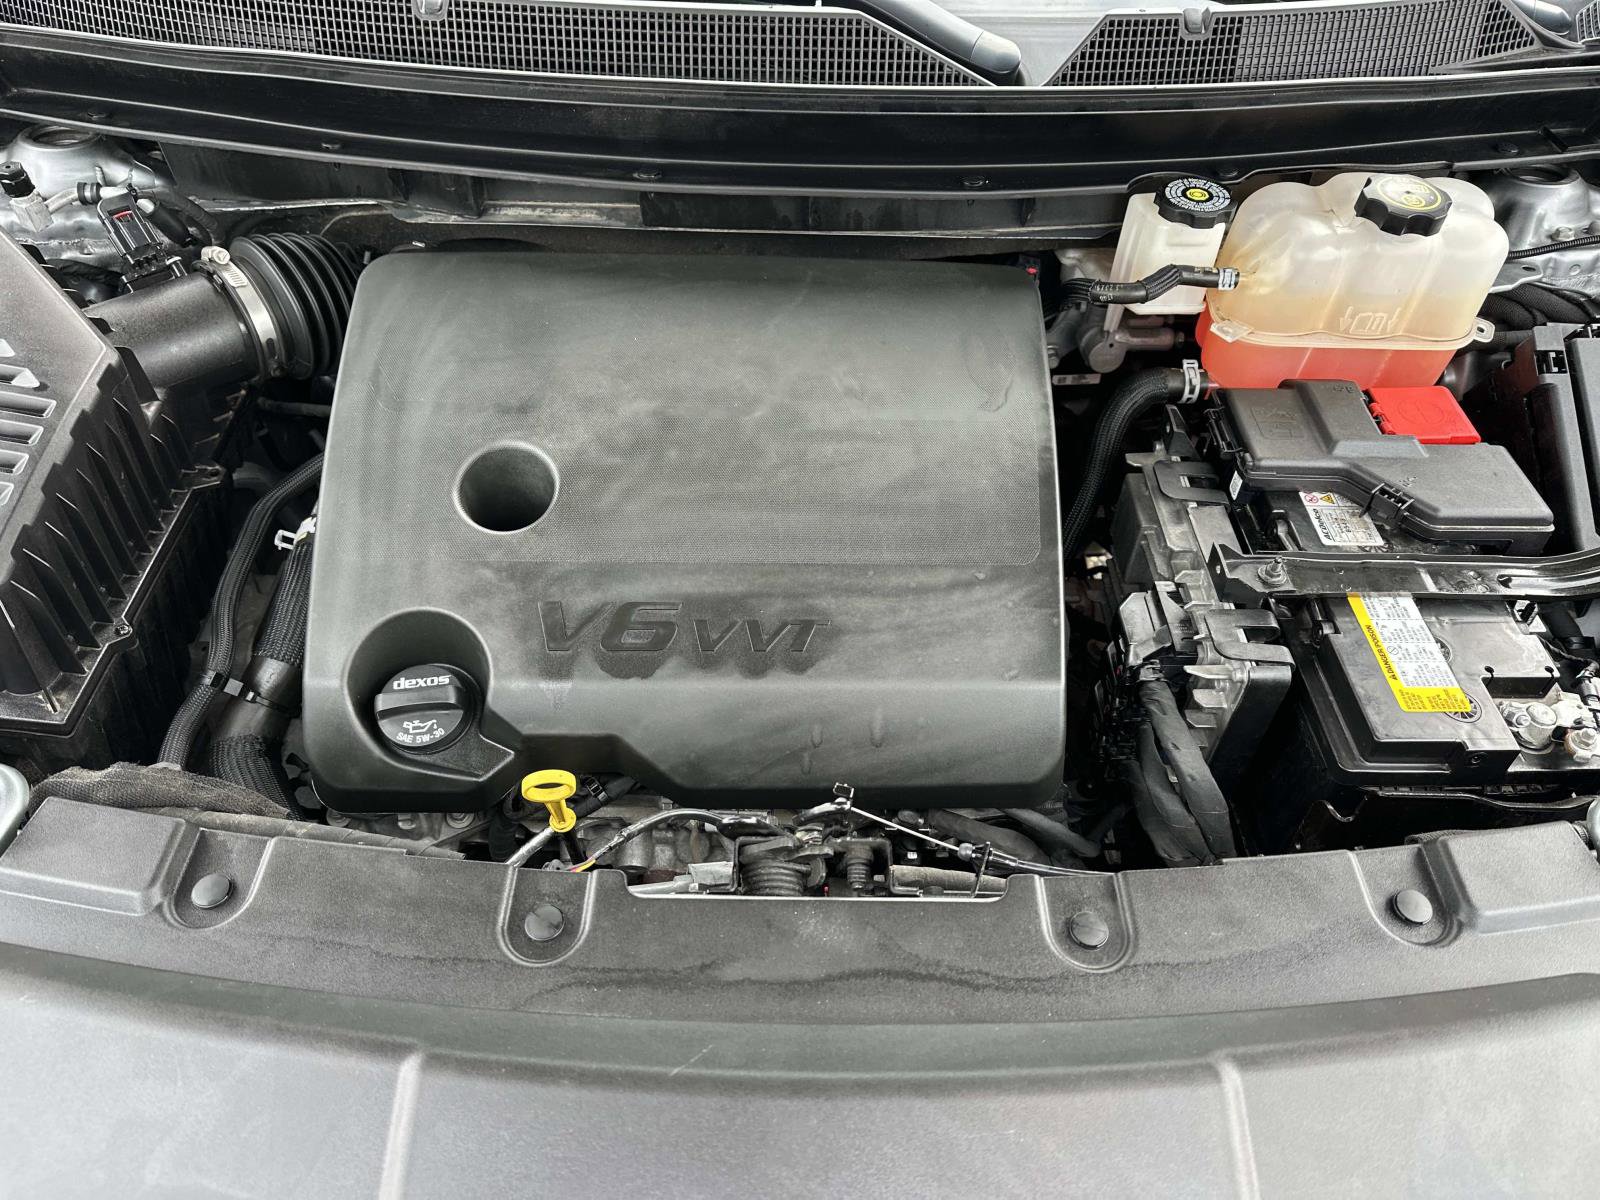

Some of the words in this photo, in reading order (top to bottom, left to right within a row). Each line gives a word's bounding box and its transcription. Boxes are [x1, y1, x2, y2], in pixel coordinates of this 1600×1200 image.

[538, 601, 684, 653] V6
[693, 618, 831, 653] VVT
[1377, 648, 1394, 674] DANGER
[393, 675, 452, 689] dexos
[396, 732, 413, 743] SAE
[416, 728, 445, 743] 5W-30
